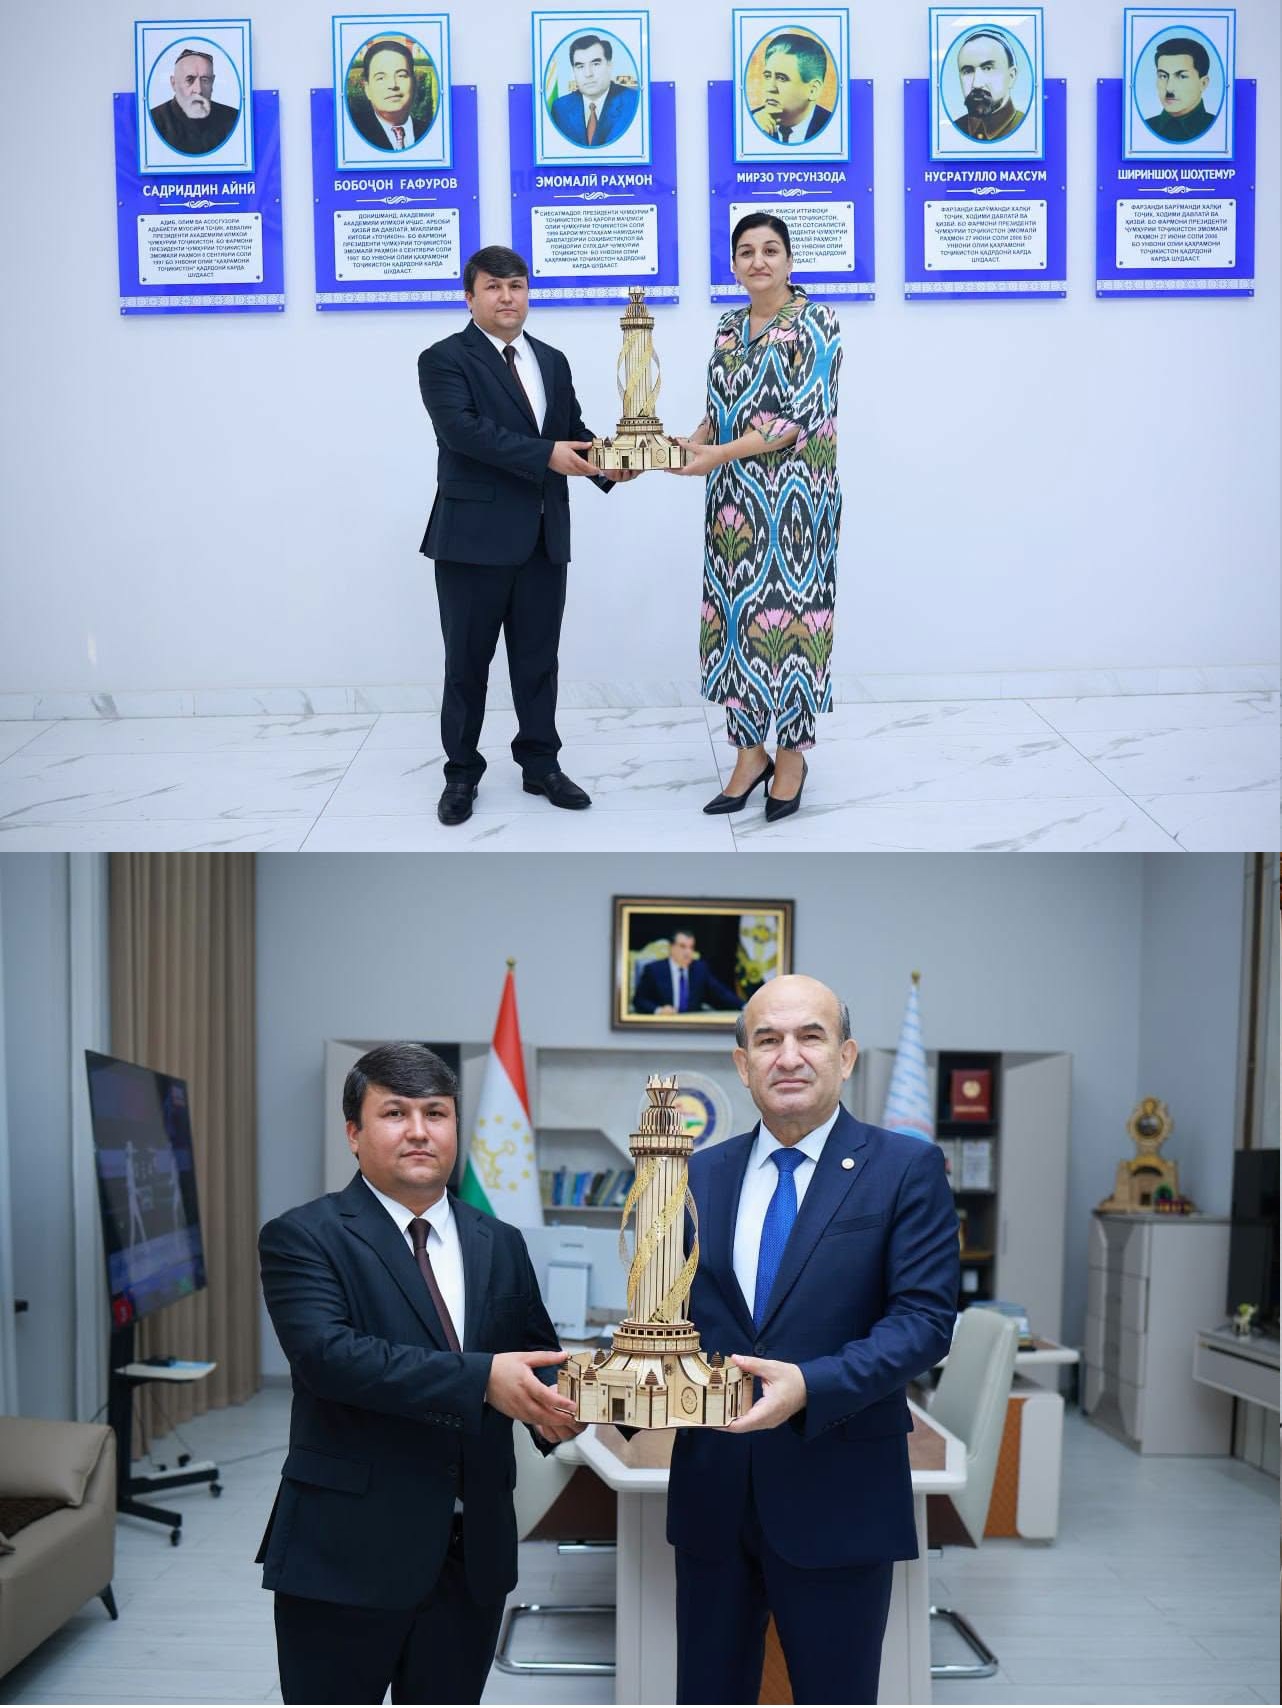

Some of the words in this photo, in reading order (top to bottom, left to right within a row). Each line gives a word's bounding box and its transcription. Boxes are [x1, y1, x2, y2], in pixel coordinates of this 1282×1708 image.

[536, 174, 597, 187] ЭМОМАЛӢ
[602, 175, 652, 187] РАҲМОН
[737, 173, 774, 182] МИРЗО
[777, 172, 846, 183] ТУРСУНЗОДА
[925, 171, 996, 181] НУСРАТУЛЛО
[1000, 171, 1046, 181] МАХСУМ
[1118, 170, 1178, 181] ШИРИНШОҲ
[1181, 170, 1235, 181] ШОҲТЕМУР
[143, 184, 217, 198] САДРИДДИН
[222, 181, 255, 194] АЙНӢ
[335, 180, 391, 192] БОБОҶОН
[401, 178, 457, 189] ҒАФУРОВ
